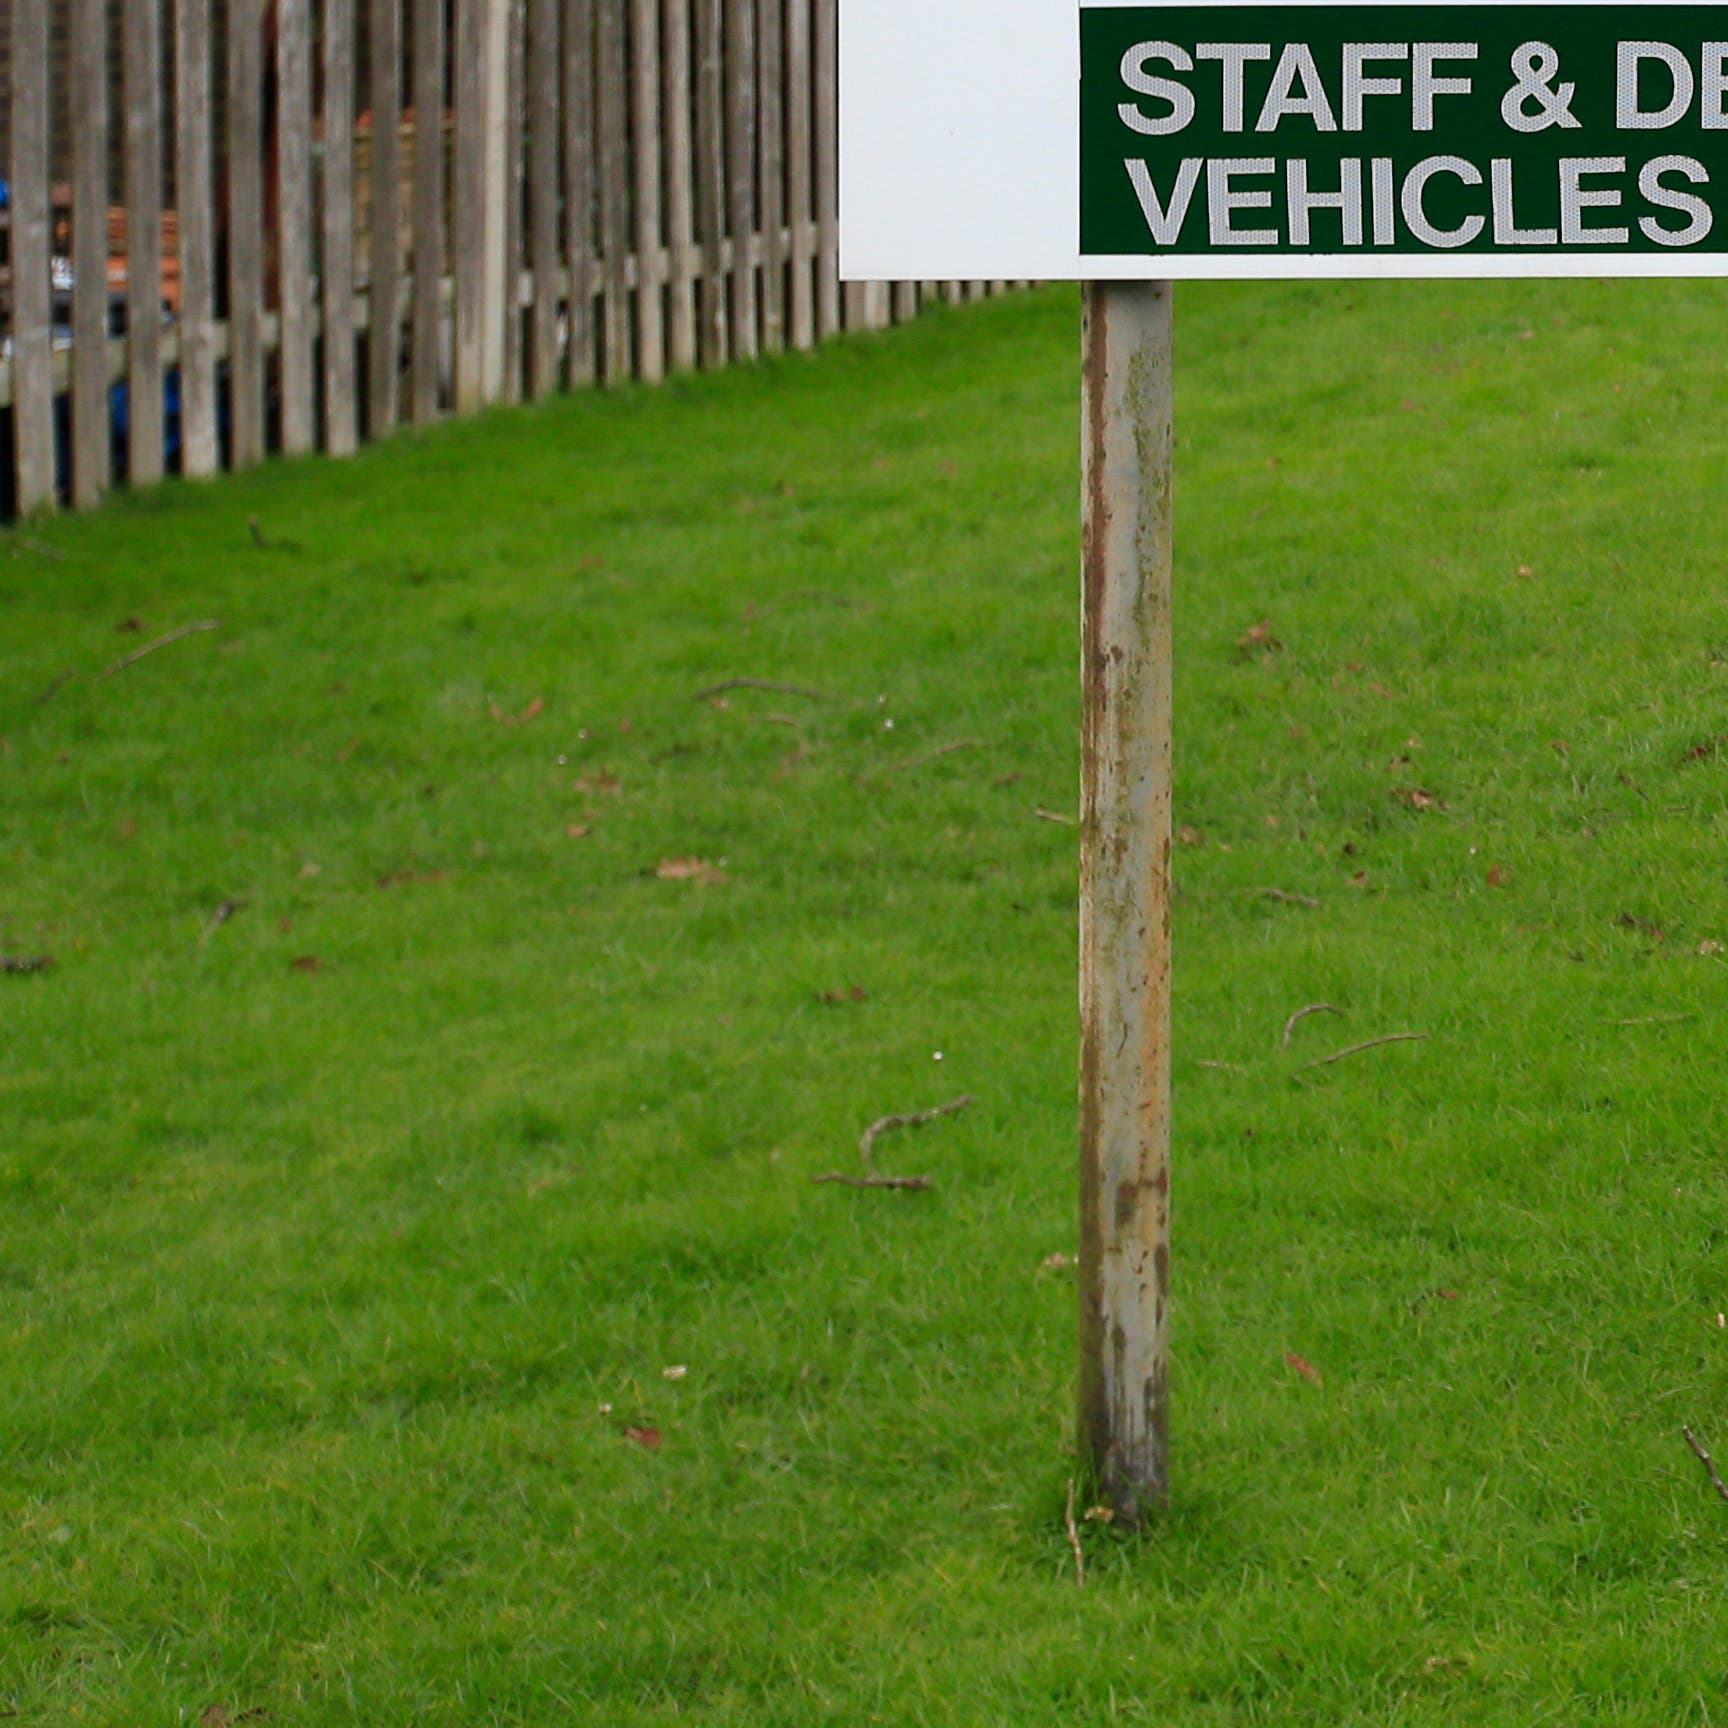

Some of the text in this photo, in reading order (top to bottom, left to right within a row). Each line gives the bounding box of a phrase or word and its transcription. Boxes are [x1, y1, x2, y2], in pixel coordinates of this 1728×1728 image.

[1118, 41, 1478, 135] STAFF
[1501, 41, 1582, 132] &
[1124, 155, 1712, 249] VEHICLES
